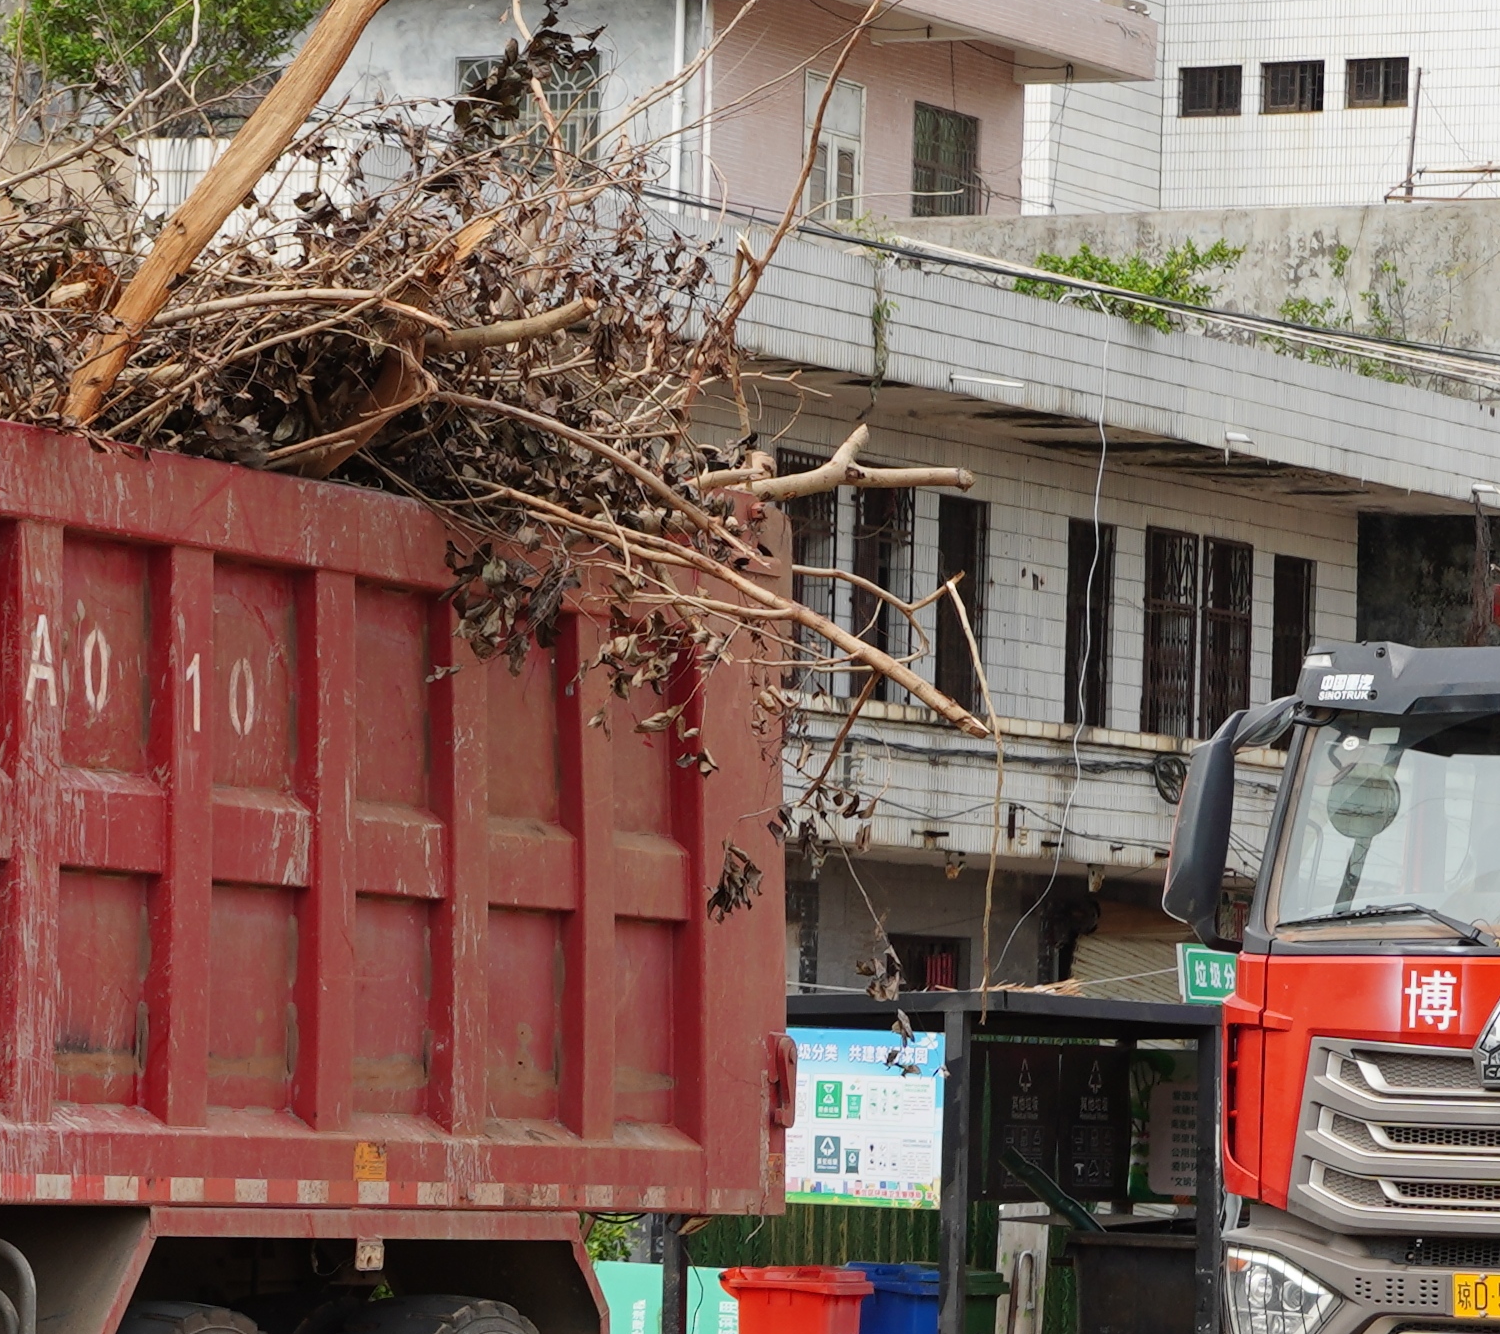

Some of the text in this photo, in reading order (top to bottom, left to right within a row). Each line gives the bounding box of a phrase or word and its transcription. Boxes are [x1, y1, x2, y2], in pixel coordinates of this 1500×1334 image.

[1318, 690, 1370, 701] SINOTRUK
[1405, 970, 1458, 1031] 博
[848, 1045, 929, 1065] 共建美家园
